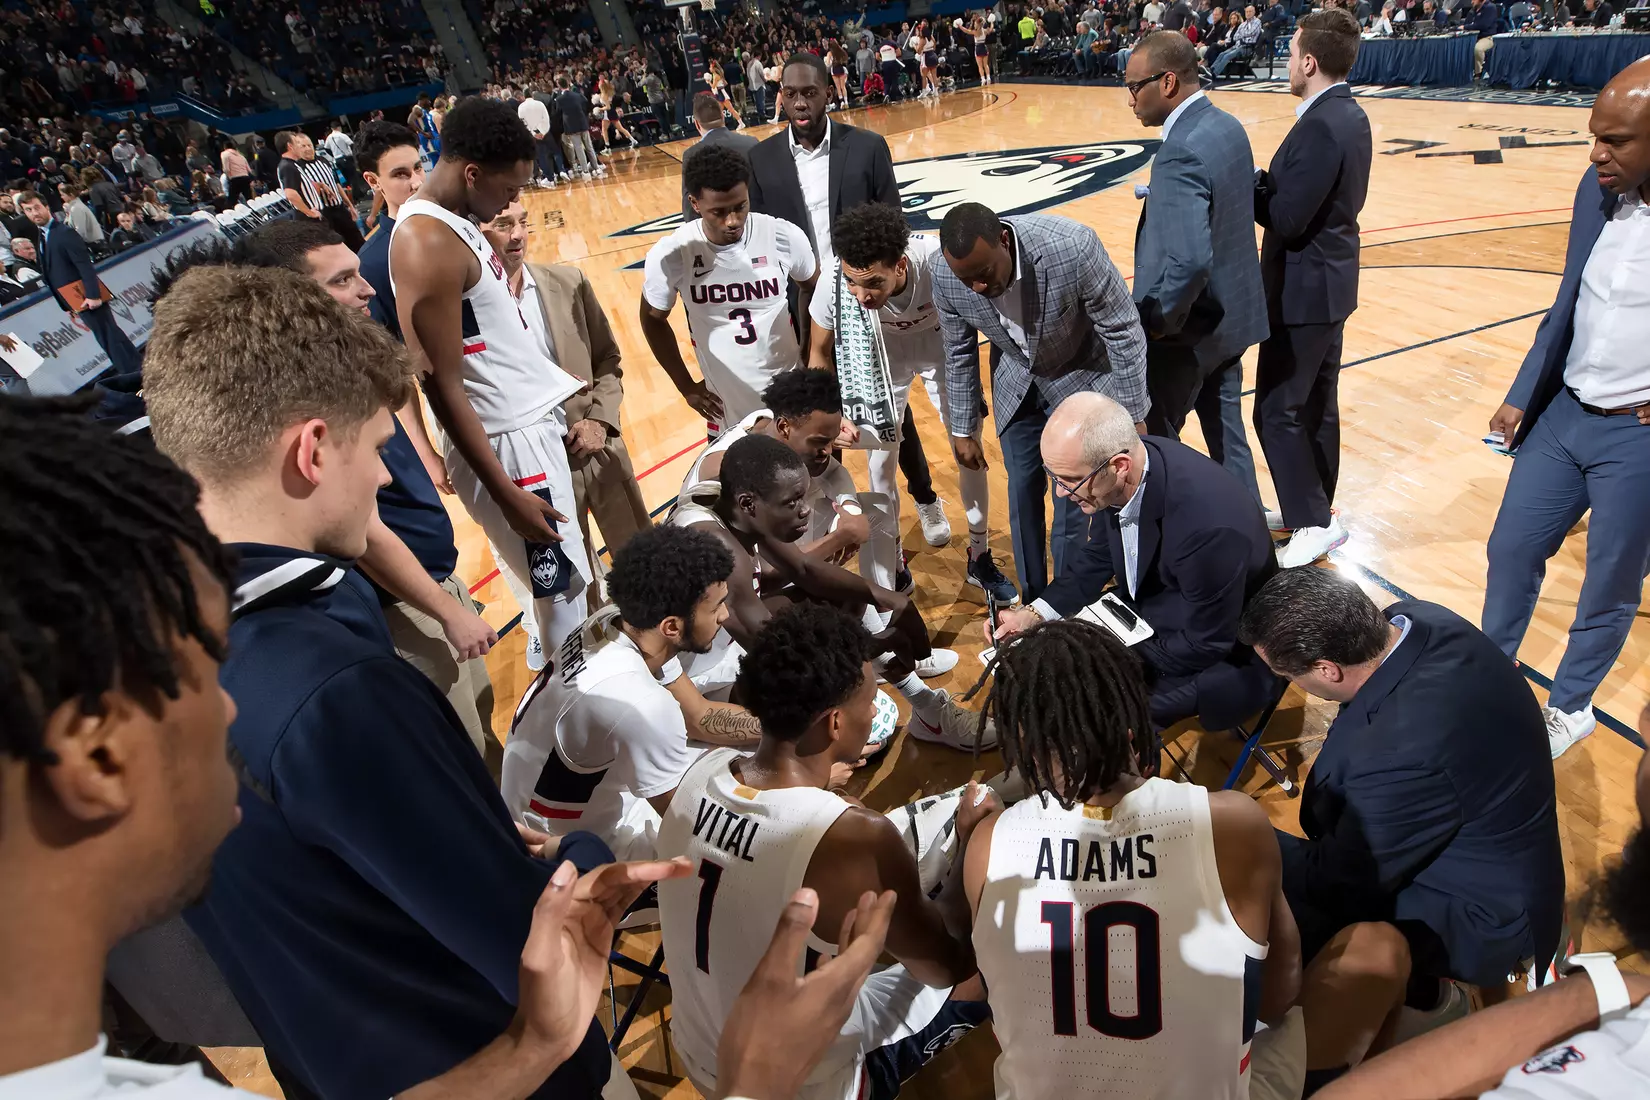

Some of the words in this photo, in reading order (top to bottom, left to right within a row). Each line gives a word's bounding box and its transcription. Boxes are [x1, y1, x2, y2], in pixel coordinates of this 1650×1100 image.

[690, 278, 780, 304] UCONN
[25, 321, 82, 359] eyBank
[728, 308, 758, 345] 3
[692, 797, 759, 862] VITAL
[1034, 833, 1157, 882] ADAMS
[695, 857, 725, 976] 1
[1040, 900, 1163, 1041] 10
